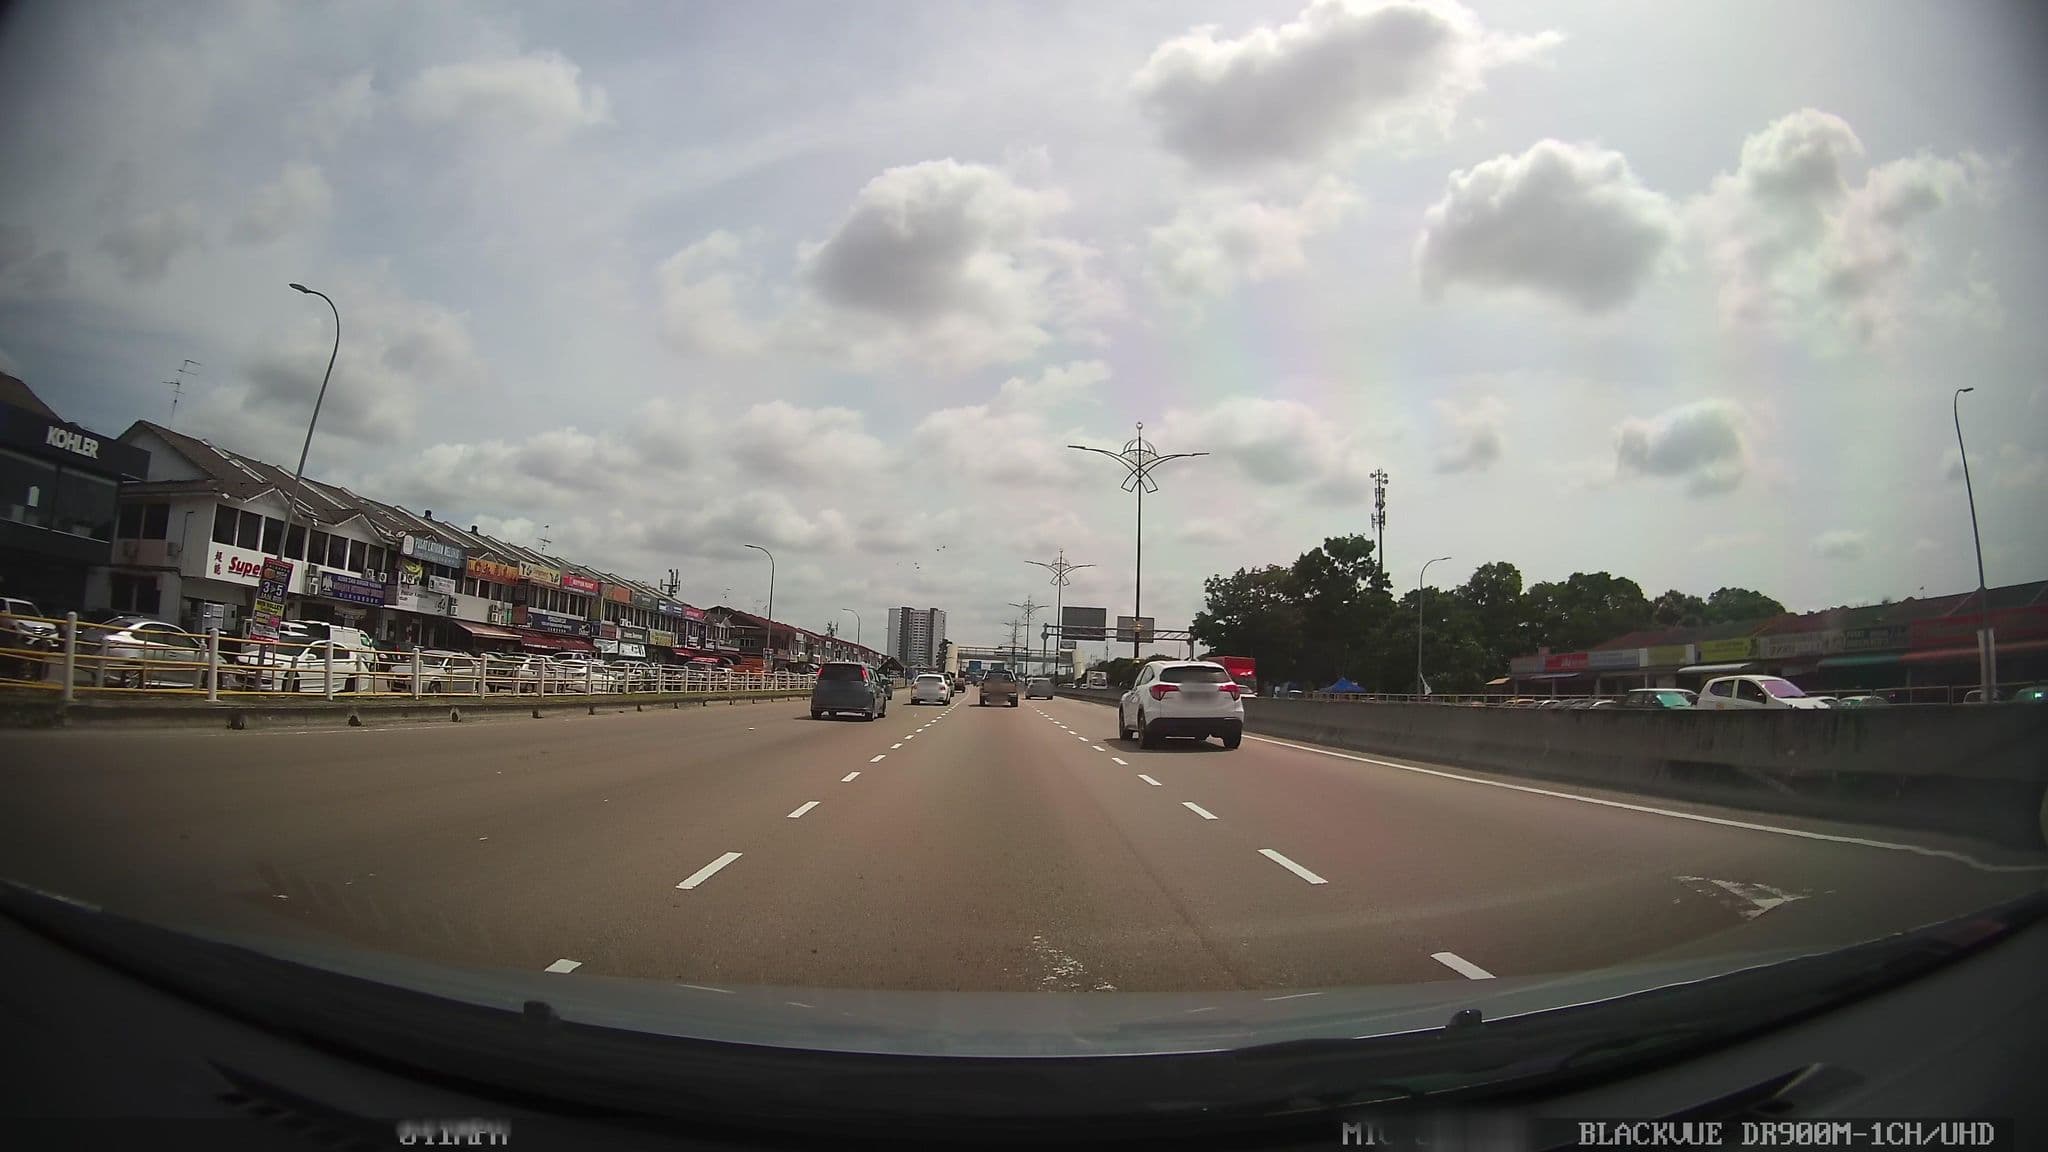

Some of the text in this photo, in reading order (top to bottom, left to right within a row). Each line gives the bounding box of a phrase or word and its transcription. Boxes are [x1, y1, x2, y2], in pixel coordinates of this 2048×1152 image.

[46, 425, 99, 459] KOHLER
[228, 556, 261, 578] Supe
[276, 584, 284, 596] 5
